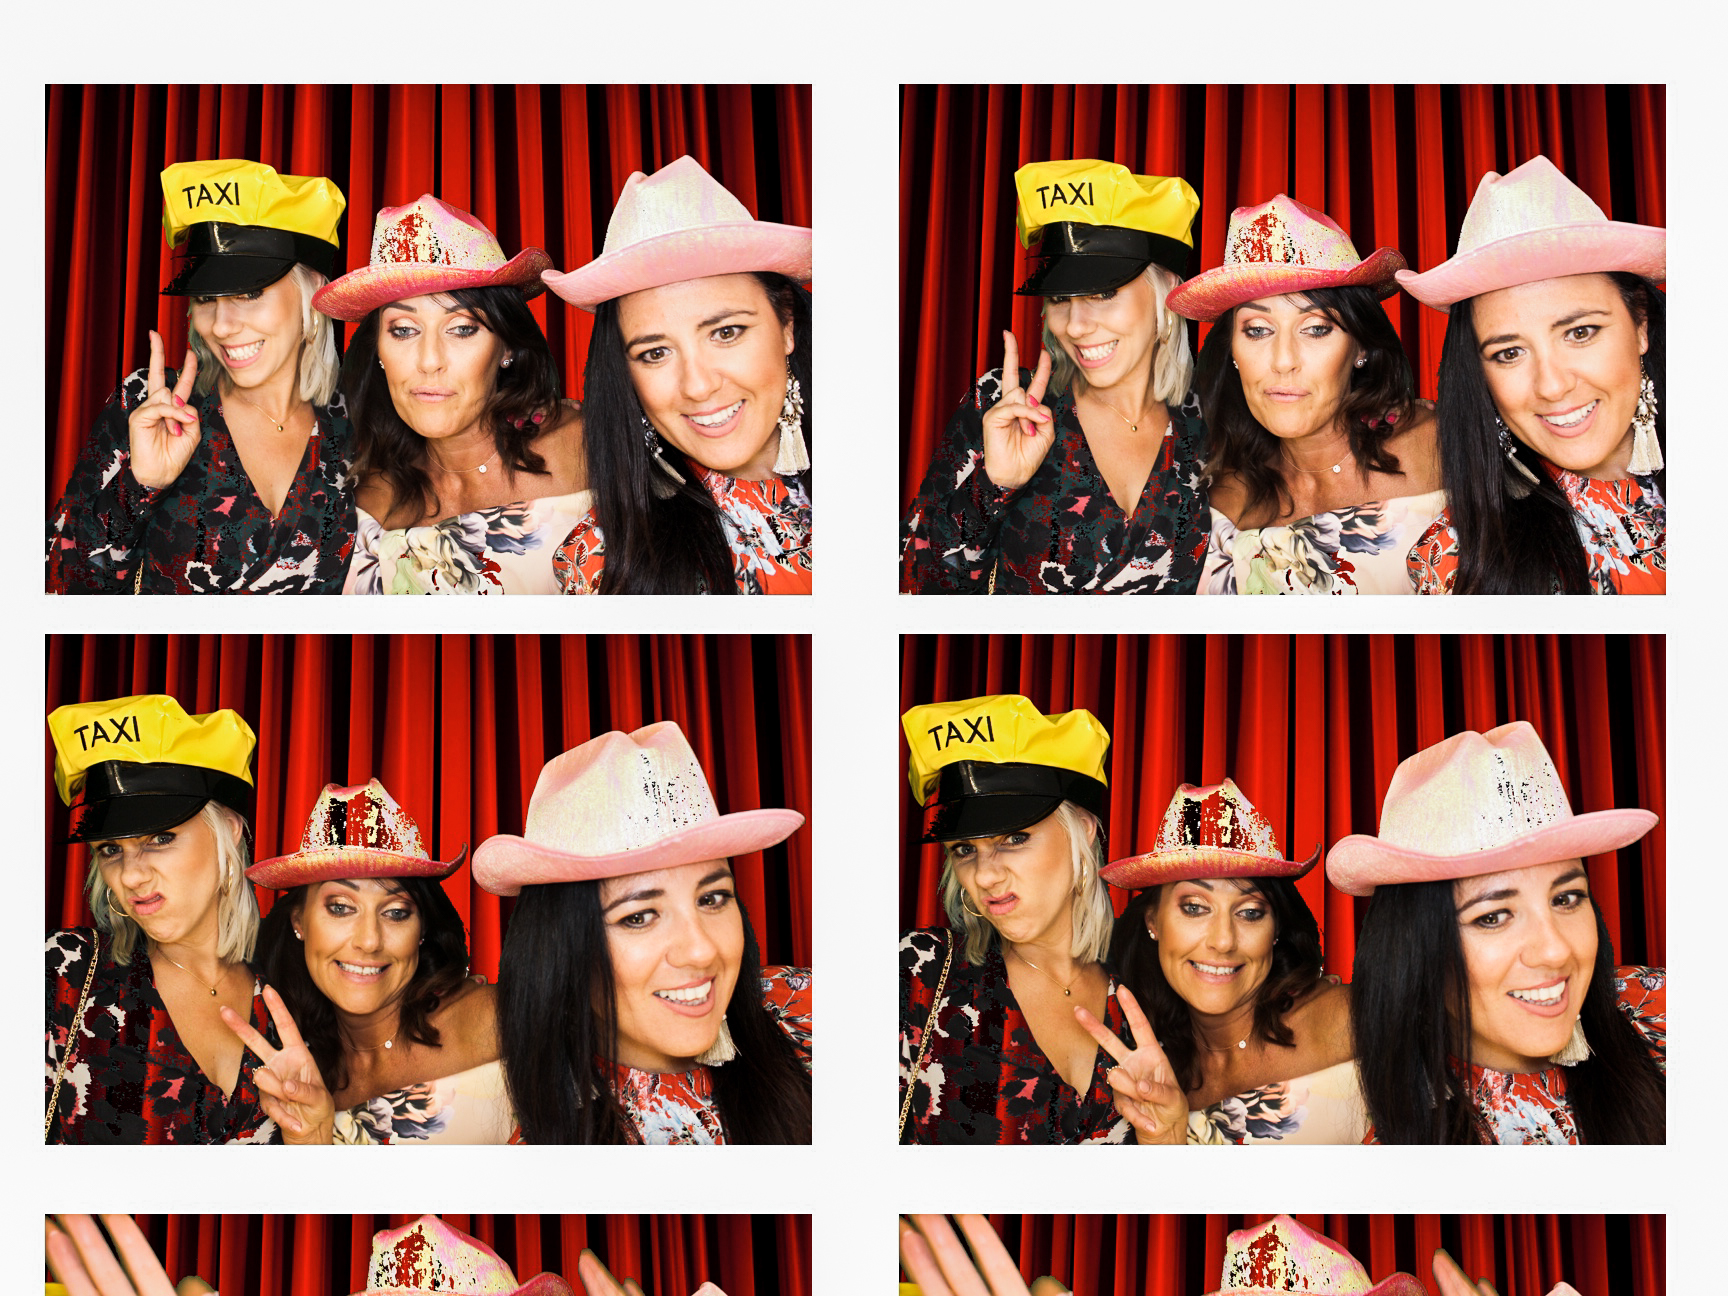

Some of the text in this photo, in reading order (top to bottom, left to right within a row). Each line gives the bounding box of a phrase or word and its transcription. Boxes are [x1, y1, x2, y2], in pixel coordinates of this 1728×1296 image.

[182, 182, 240, 209] TAXI
[1036, 182, 1094, 209] TAXI
[73, 716, 140, 751] TAXI
[927, 716, 994, 751] TAXI
